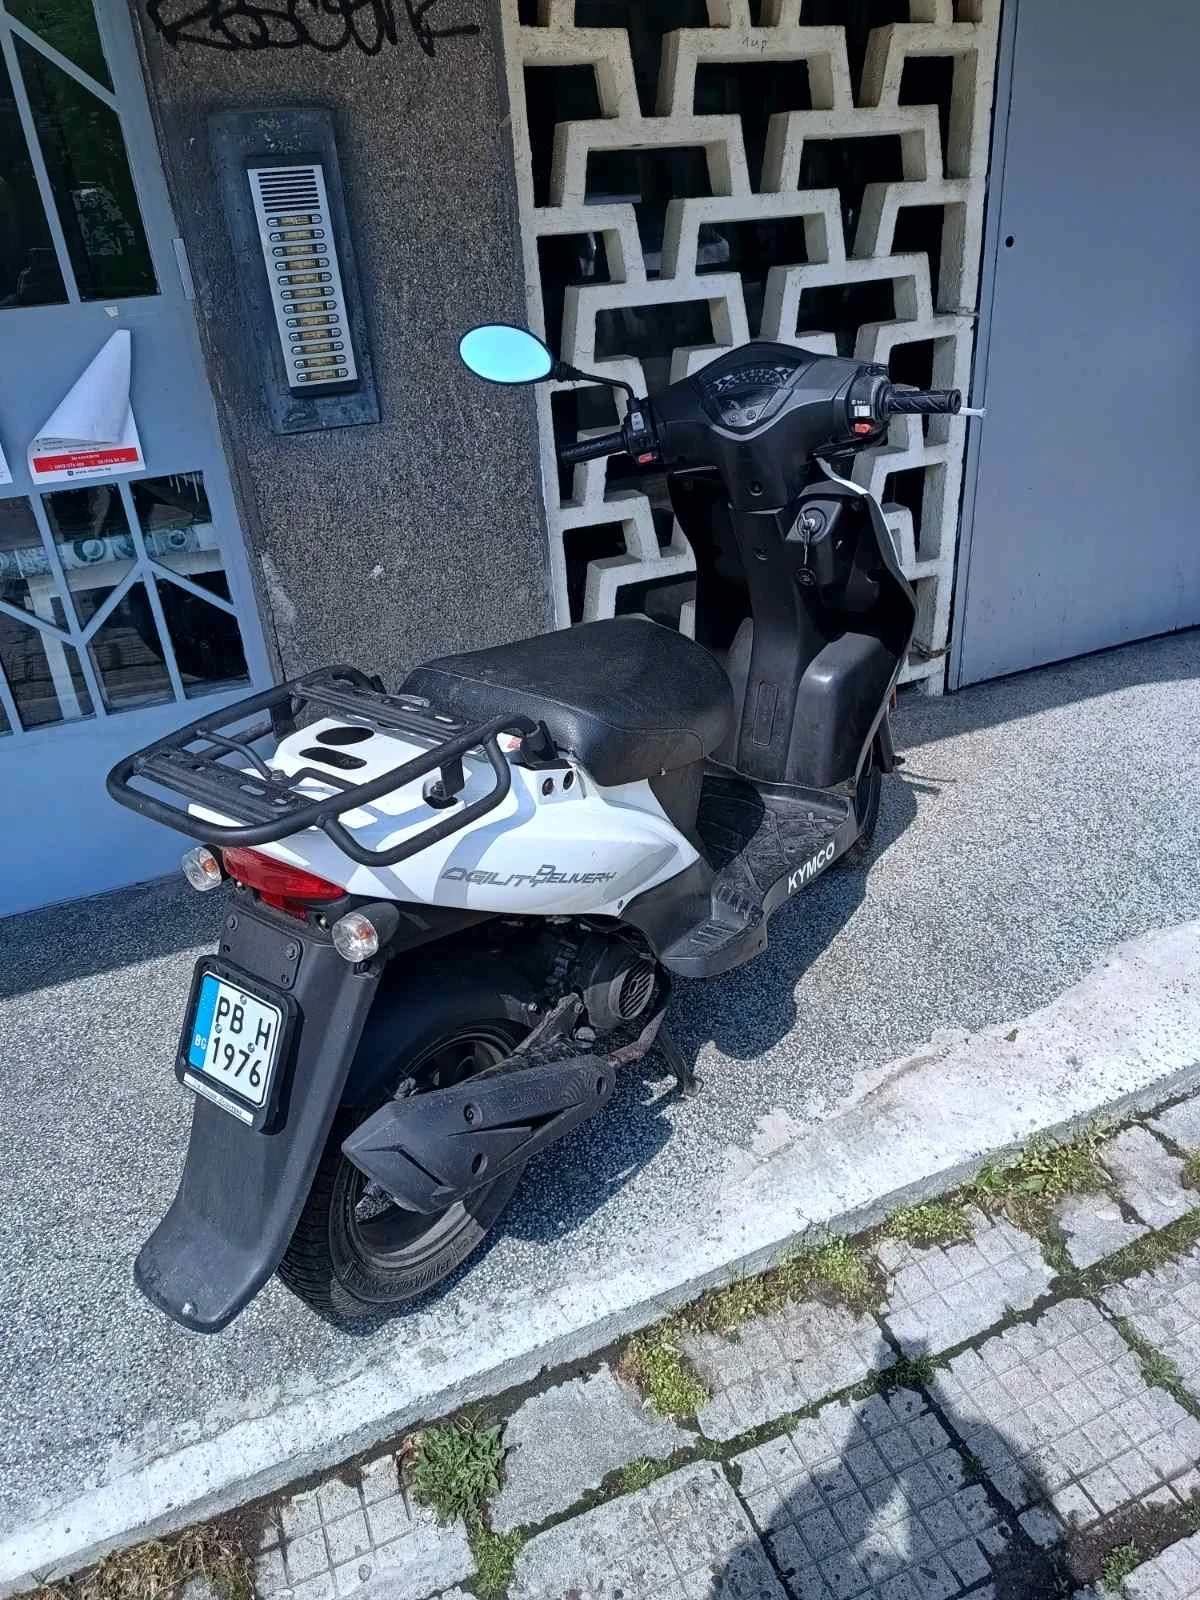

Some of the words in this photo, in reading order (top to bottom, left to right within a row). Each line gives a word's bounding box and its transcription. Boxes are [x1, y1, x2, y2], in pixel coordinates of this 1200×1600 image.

[788, 842, 834, 894] KYMCO
[194, 1034, 207, 1050] BG
[215, 996, 245, 1034] PB
[255, 1017, 272, 1050] H
[212, 1037, 262, 1087] 1976
